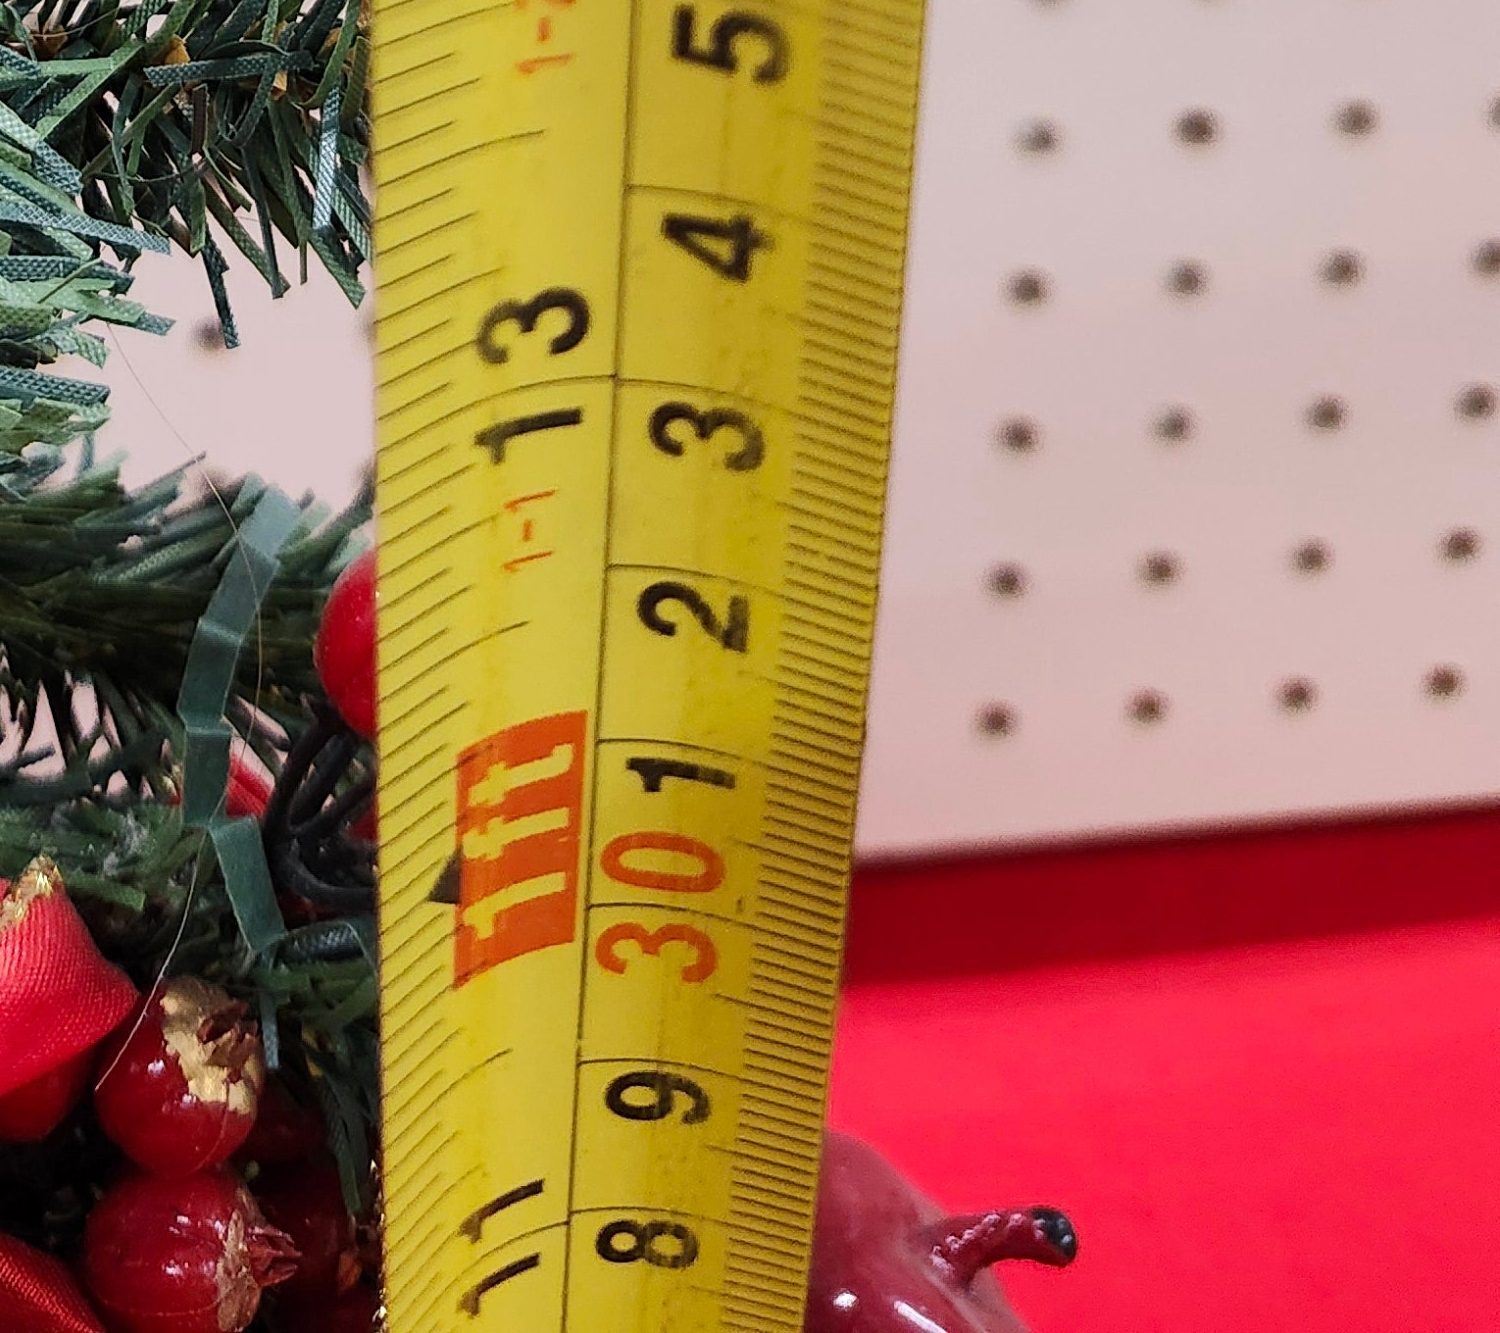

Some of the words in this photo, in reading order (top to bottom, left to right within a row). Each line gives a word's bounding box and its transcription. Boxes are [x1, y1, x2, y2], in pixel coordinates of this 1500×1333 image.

[670, 3, 793, 86] 5
[662, 213, 776, 283] 4
[475, 286, 592, 464] 13
[648, 401, 766, 472] 3
[637, 581, 750, 653] 2
[626, 757, 736, 793] 1
[594, 832, 727, 983] 30
[604, 1071, 713, 1125] 9
[457, 1179, 546, 1317] 11
[595, 1219, 699, 1269] 8
